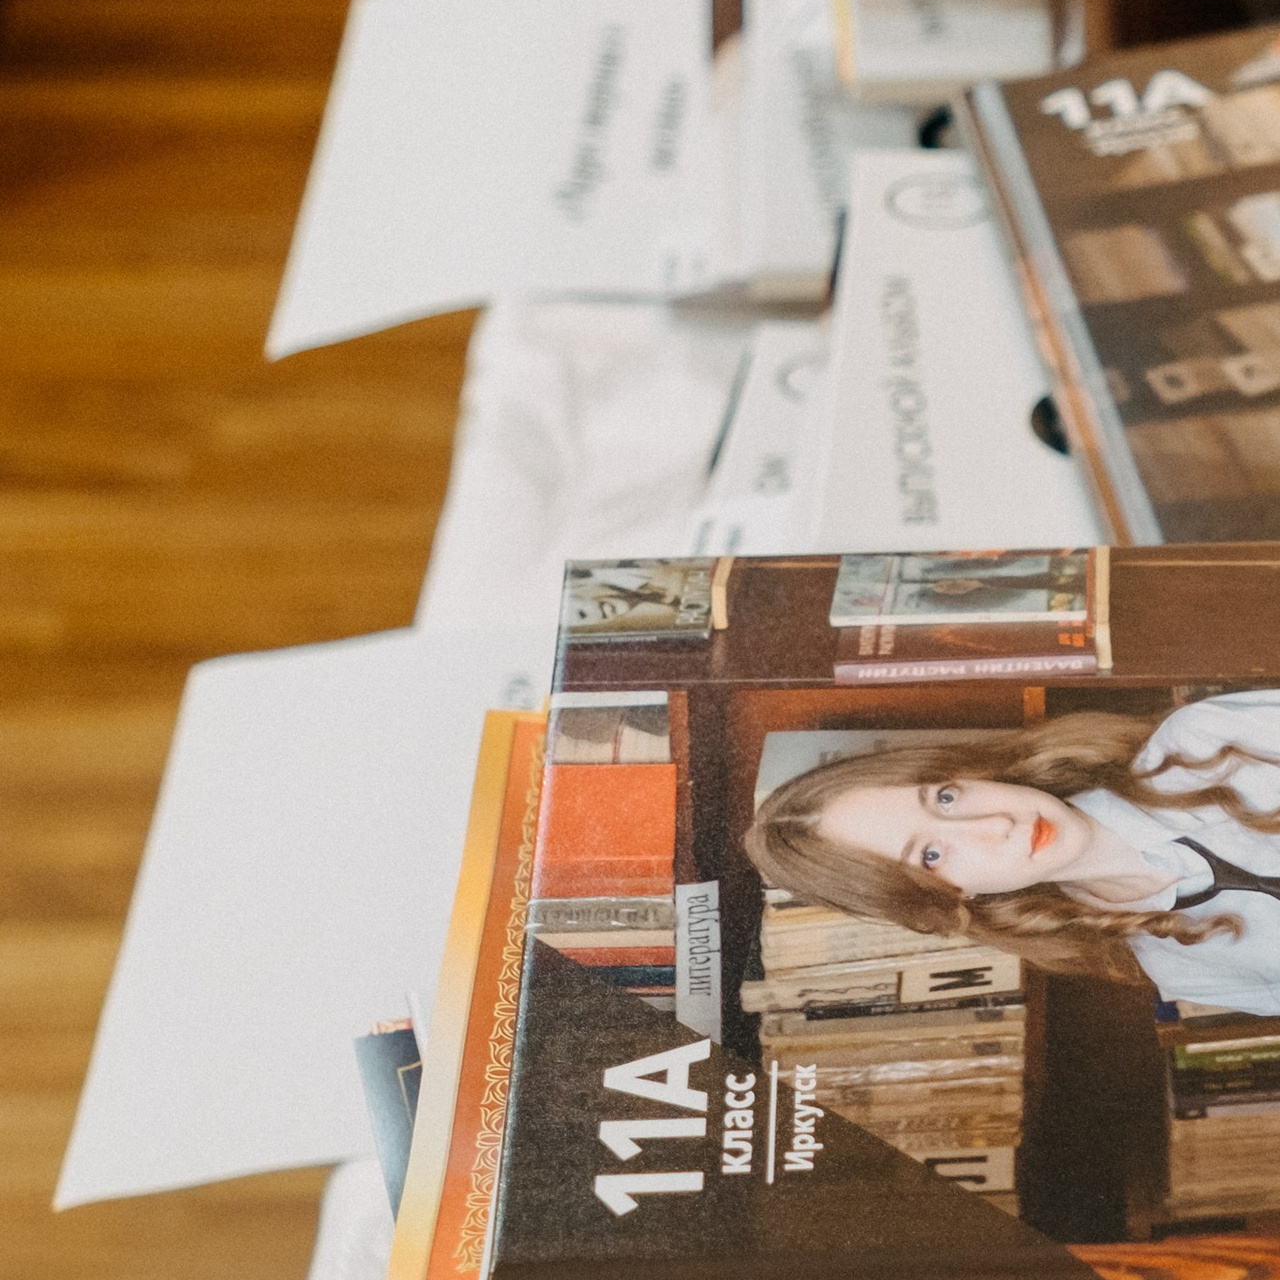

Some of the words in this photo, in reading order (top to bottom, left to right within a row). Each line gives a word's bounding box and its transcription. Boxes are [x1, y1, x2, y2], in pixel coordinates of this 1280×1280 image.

[687, 893, 720, 997] литература
[595, 1039, 711, 1216] 11А
[722, 1071, 757, 1174] класс
[783, 1064, 821, 1173] Иркутск
